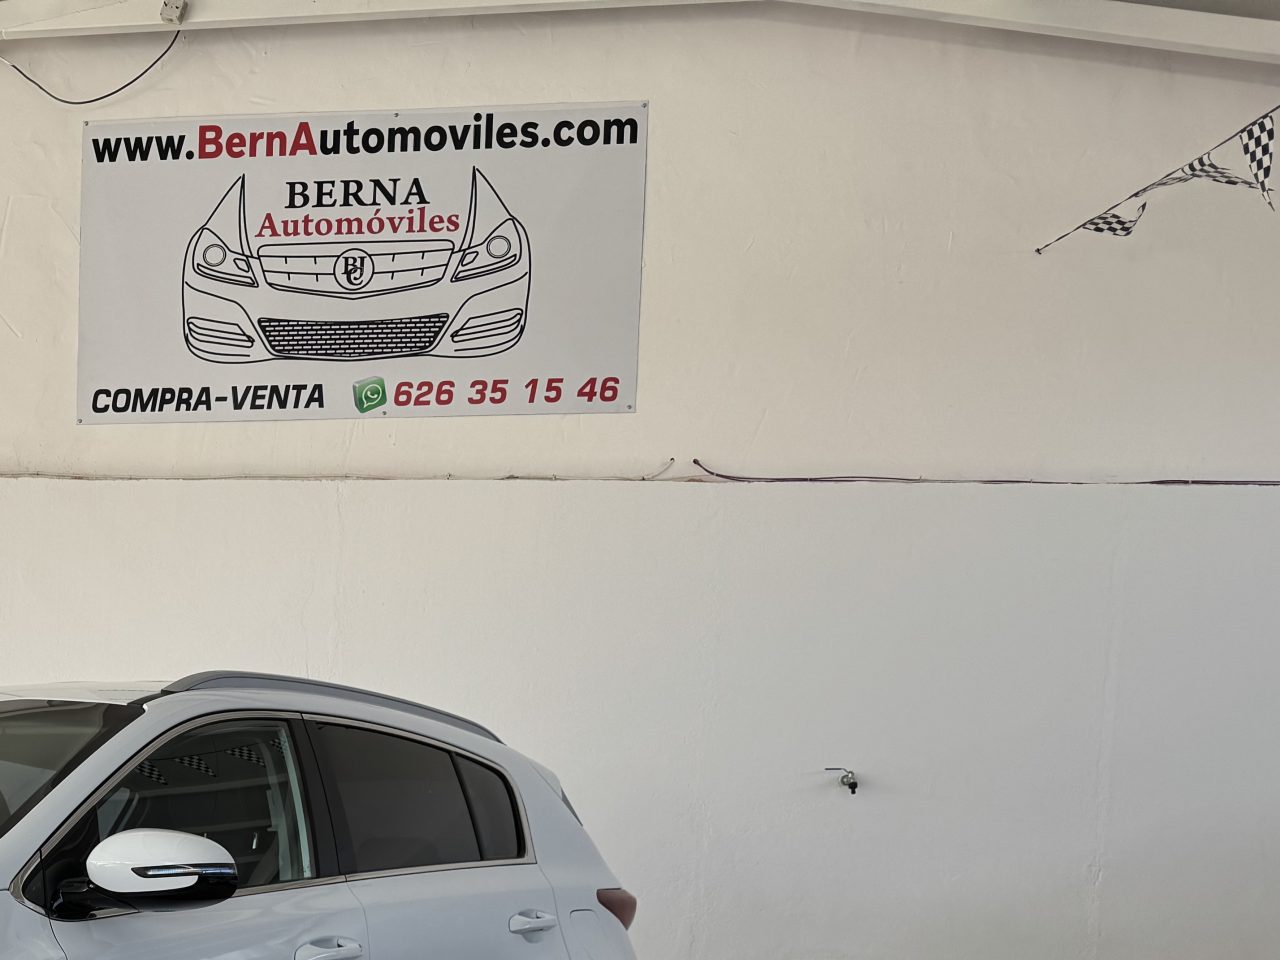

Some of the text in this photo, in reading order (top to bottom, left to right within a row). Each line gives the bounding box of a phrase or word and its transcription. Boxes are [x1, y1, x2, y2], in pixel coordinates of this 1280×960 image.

[91, 112, 639, 163] www.BernAutomoviles.com
[284, 177, 431, 209] BERNA
[254, 206, 461, 238] Automóviles
[91, 383, 325, 414] COMPRA-VENTA
[393, 376, 621, 407] 626 35 15 46
